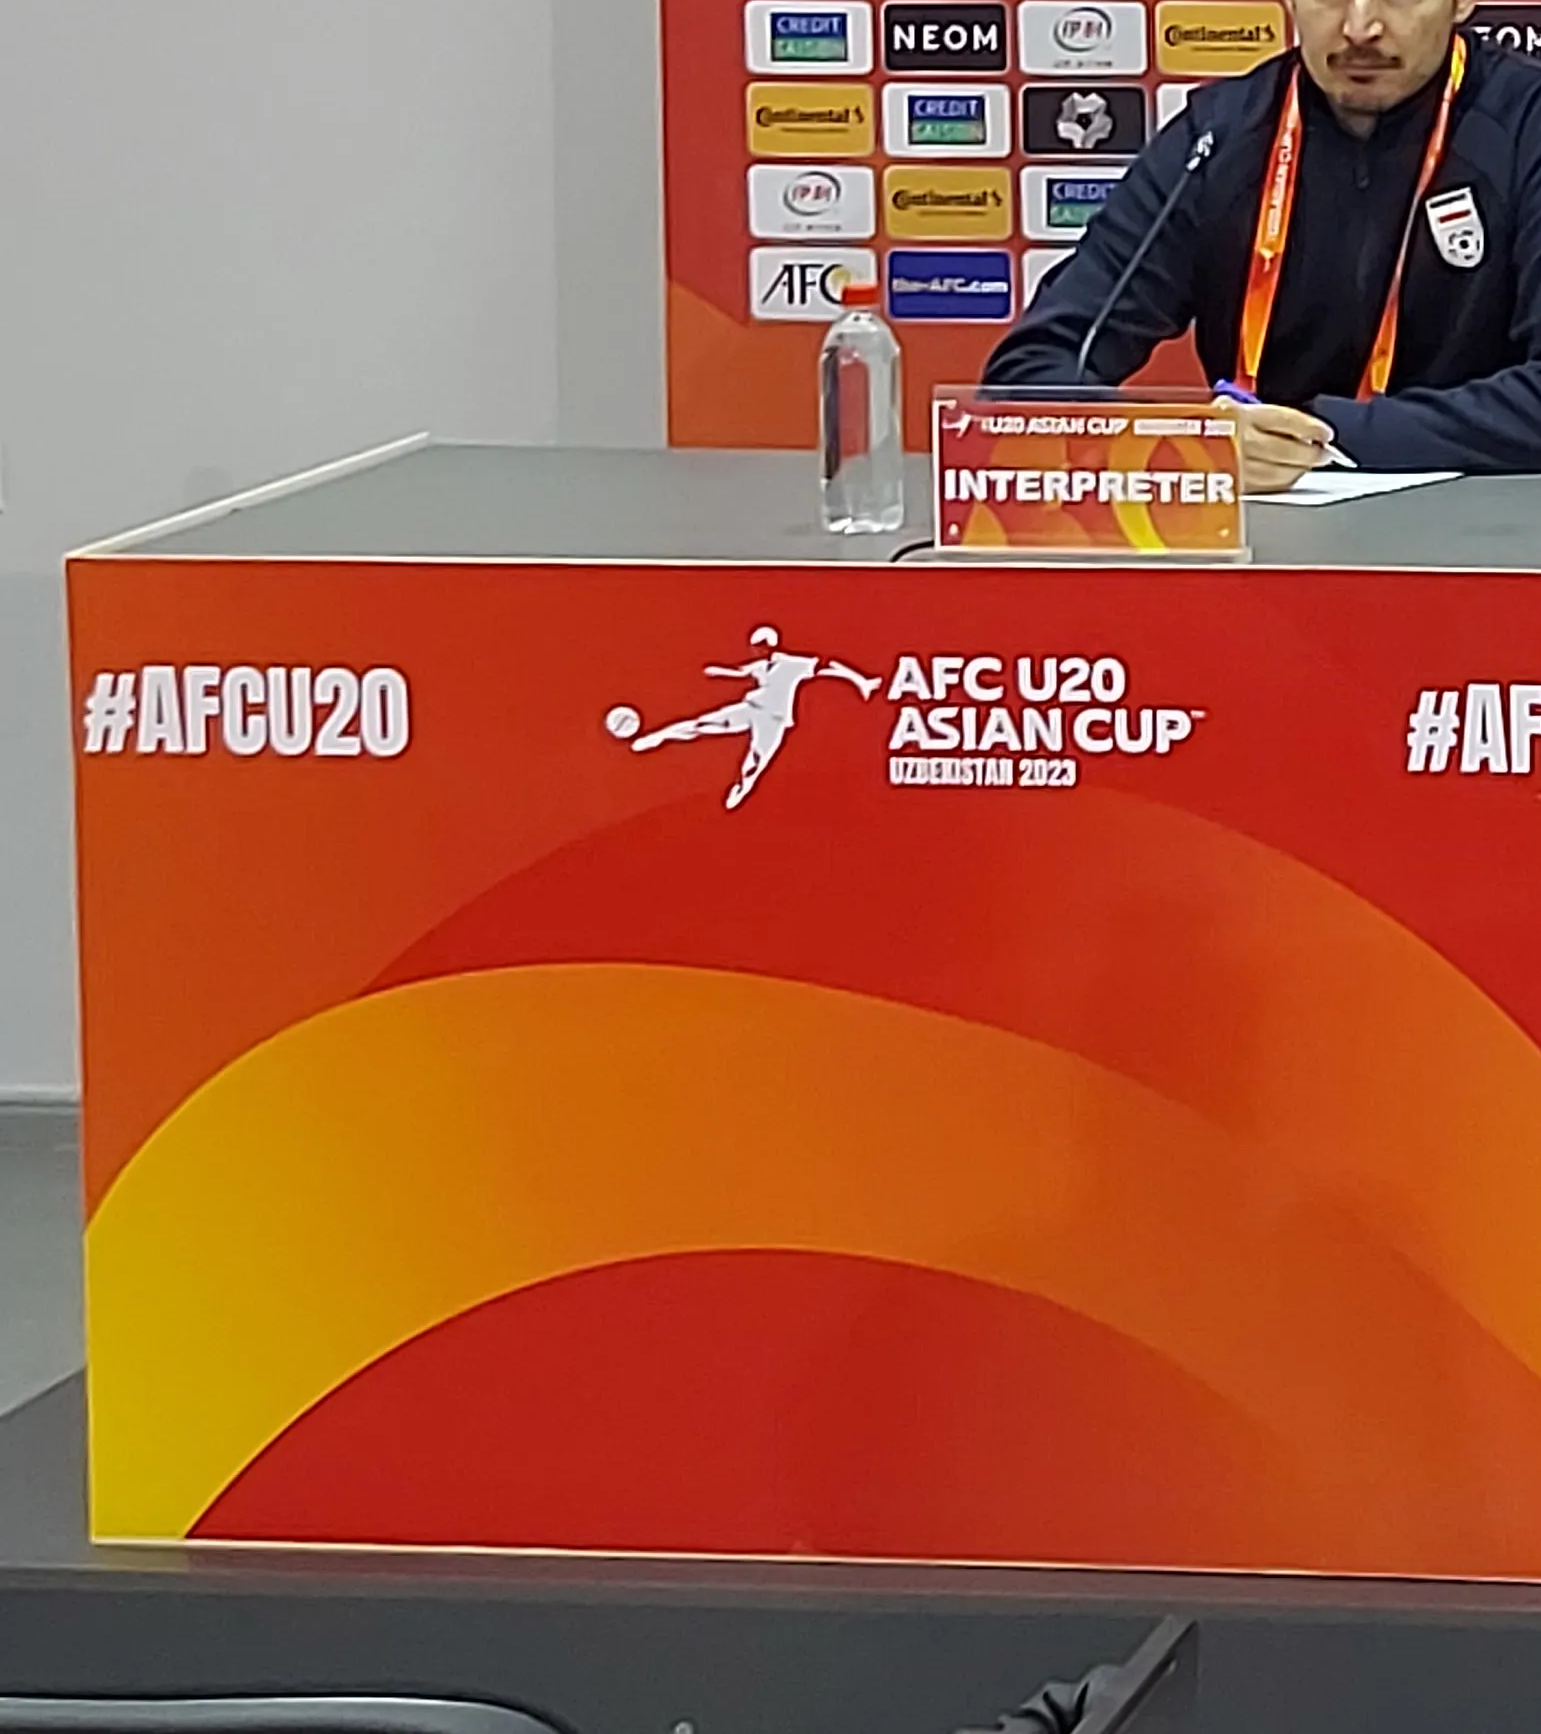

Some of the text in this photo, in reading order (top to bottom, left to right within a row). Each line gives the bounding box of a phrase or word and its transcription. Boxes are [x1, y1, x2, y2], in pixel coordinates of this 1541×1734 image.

[894, 25, 997, 50] NEOM
[944, 469, 1234, 504] INTERPRETER
[888, 656, 1126, 703] AFC U20
[84, 666, 408, 756] #AFCU20
[888, 707, 1192, 753] ASIAN CUP
[1019, 758, 1076, 787] 2023
